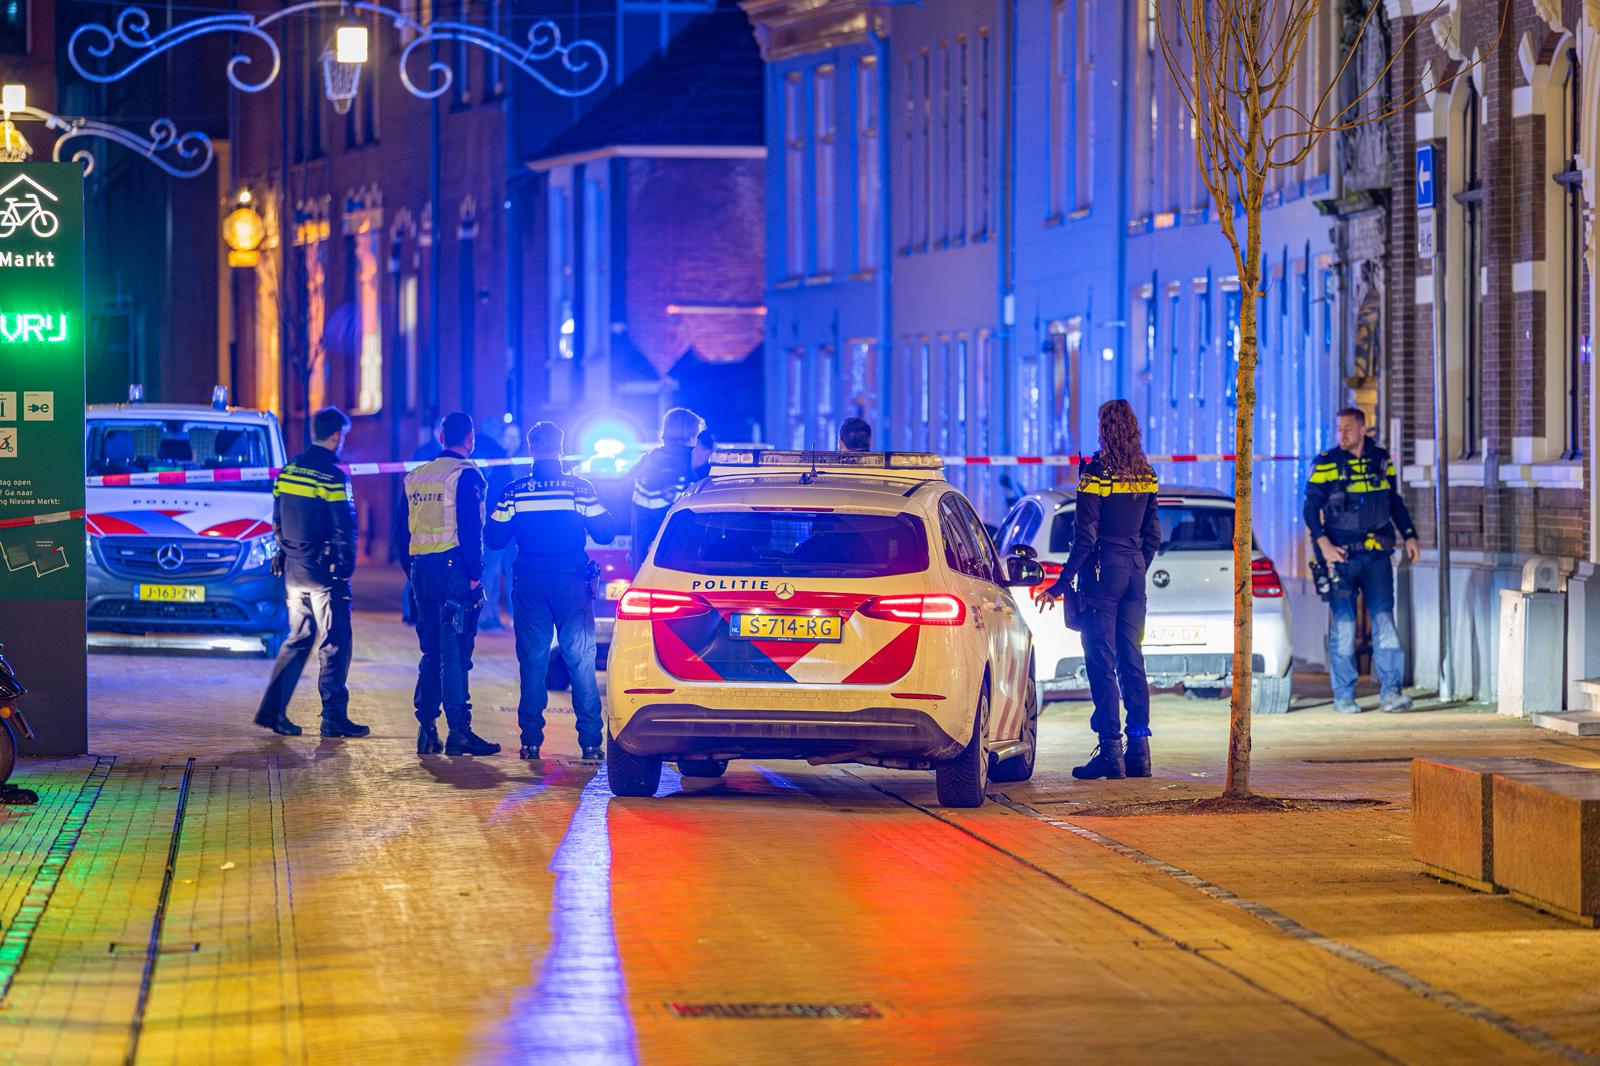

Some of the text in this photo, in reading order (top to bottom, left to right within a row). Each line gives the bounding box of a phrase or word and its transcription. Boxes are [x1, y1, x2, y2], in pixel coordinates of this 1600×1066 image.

[0, 251, 55, 267] Markt
[692, 580, 769, 590] POLITIE
[749, 617, 832, 636] S-714-RG
